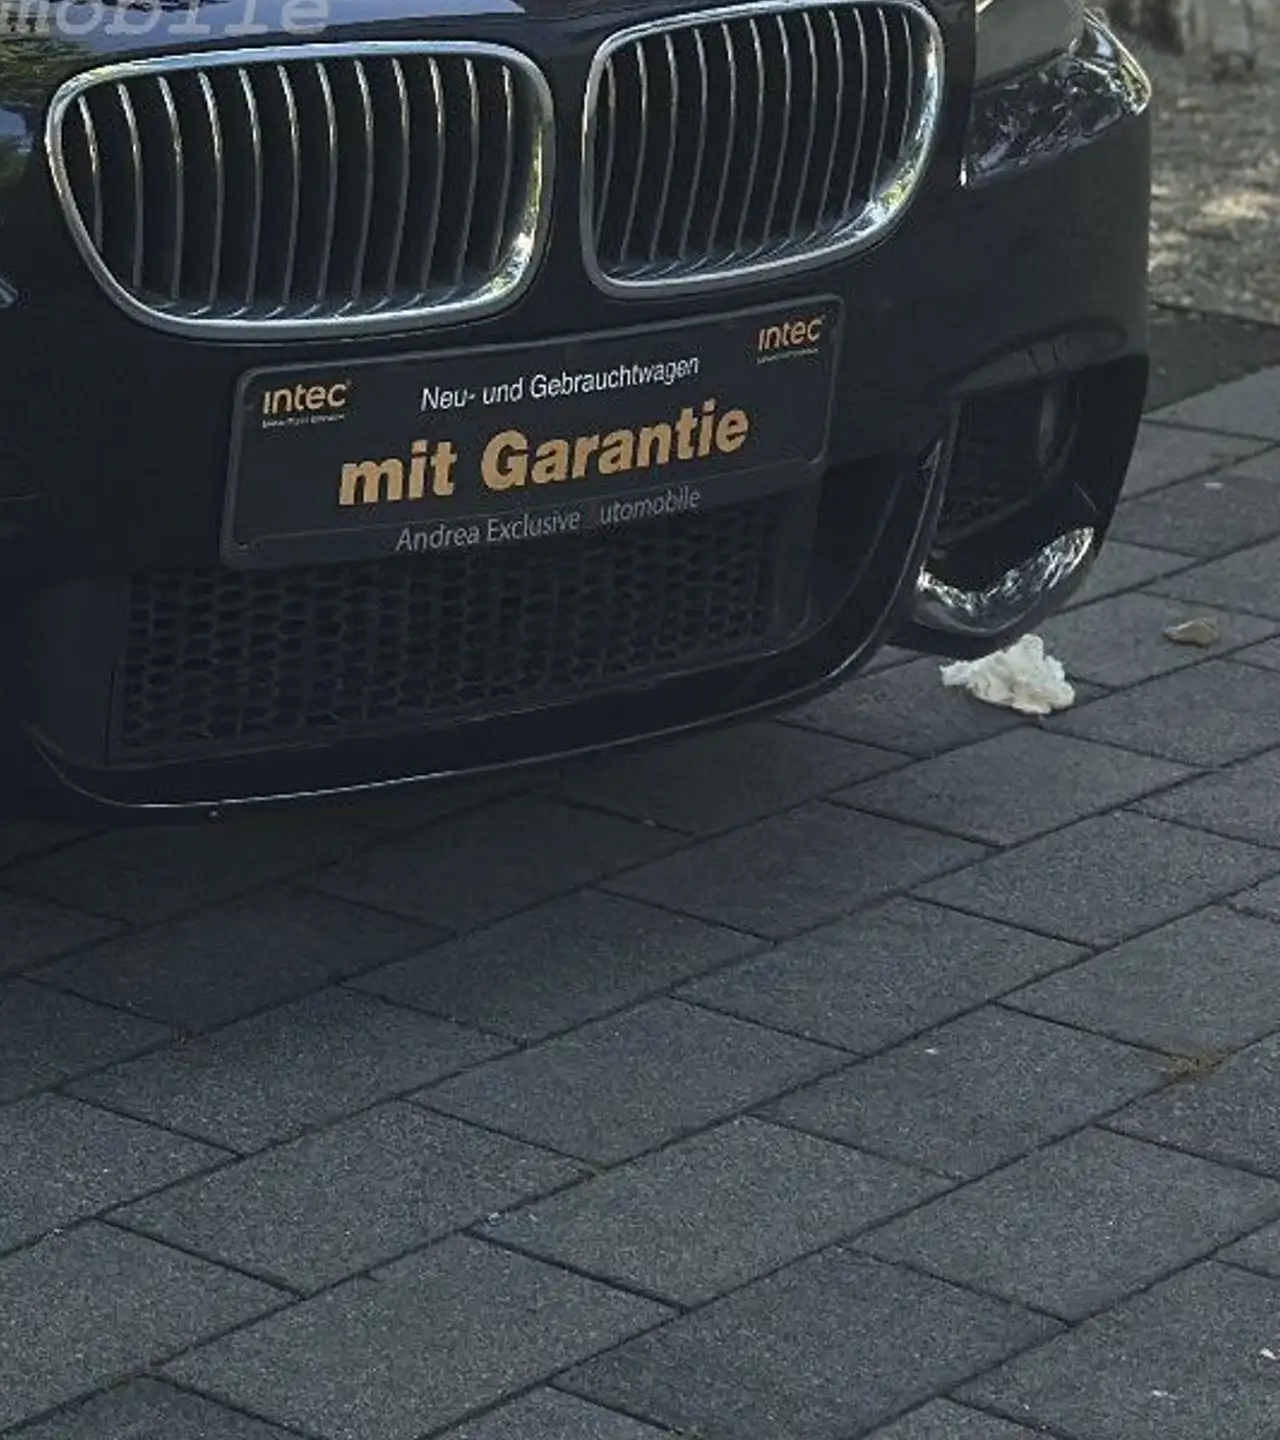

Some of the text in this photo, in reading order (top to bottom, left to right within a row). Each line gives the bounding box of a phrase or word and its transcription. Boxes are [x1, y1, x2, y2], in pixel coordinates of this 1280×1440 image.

[421, 357, 700, 410] Neu- und Gebrauchtwagen
[339, 398, 750, 506] mit Garantie
[396, 484, 701, 553] Andrea Exclusive utomobile
